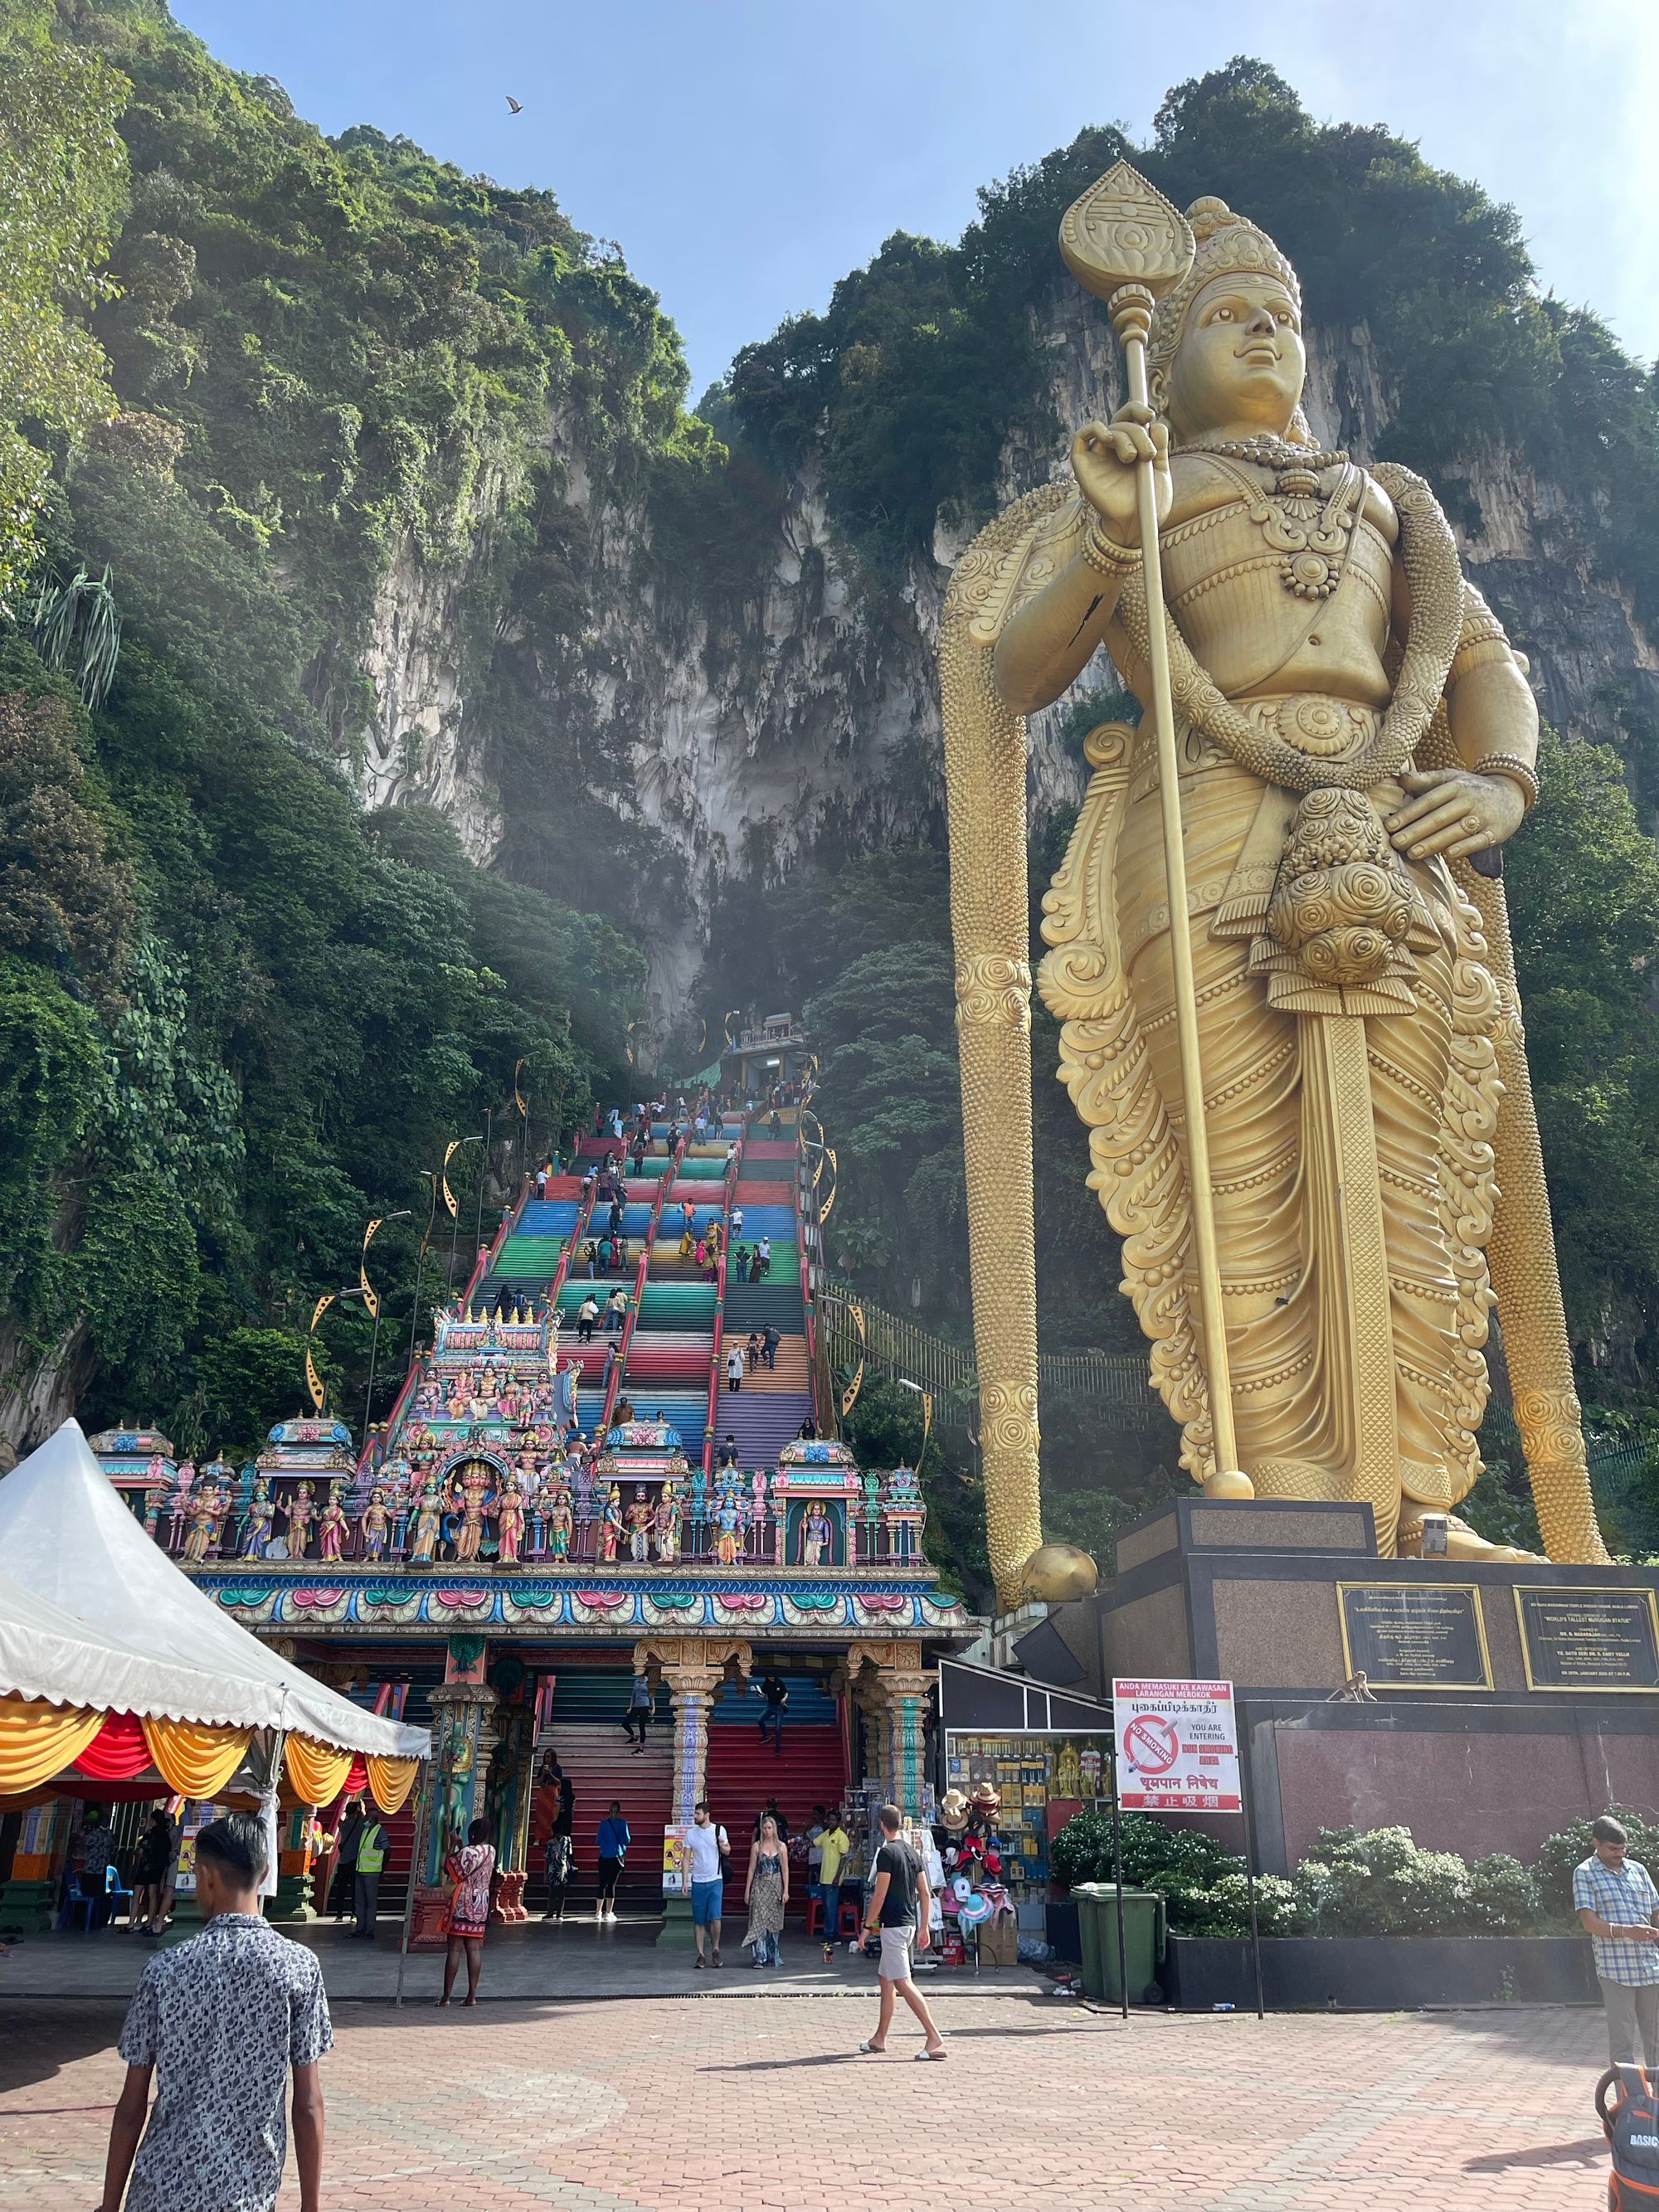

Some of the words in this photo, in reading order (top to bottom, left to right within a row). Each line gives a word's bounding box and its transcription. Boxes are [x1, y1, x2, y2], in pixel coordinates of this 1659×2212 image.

[1119, 1682, 1140, 1690] ANDA
[1141, 1683, 1180, 1691] MEMASUKI
[1130, 1723, 1142, 1735] NO
[1141, 1733, 1173, 1765] SMOKING
[1143, 1794, 1219, 1807] 禁止吸烟
